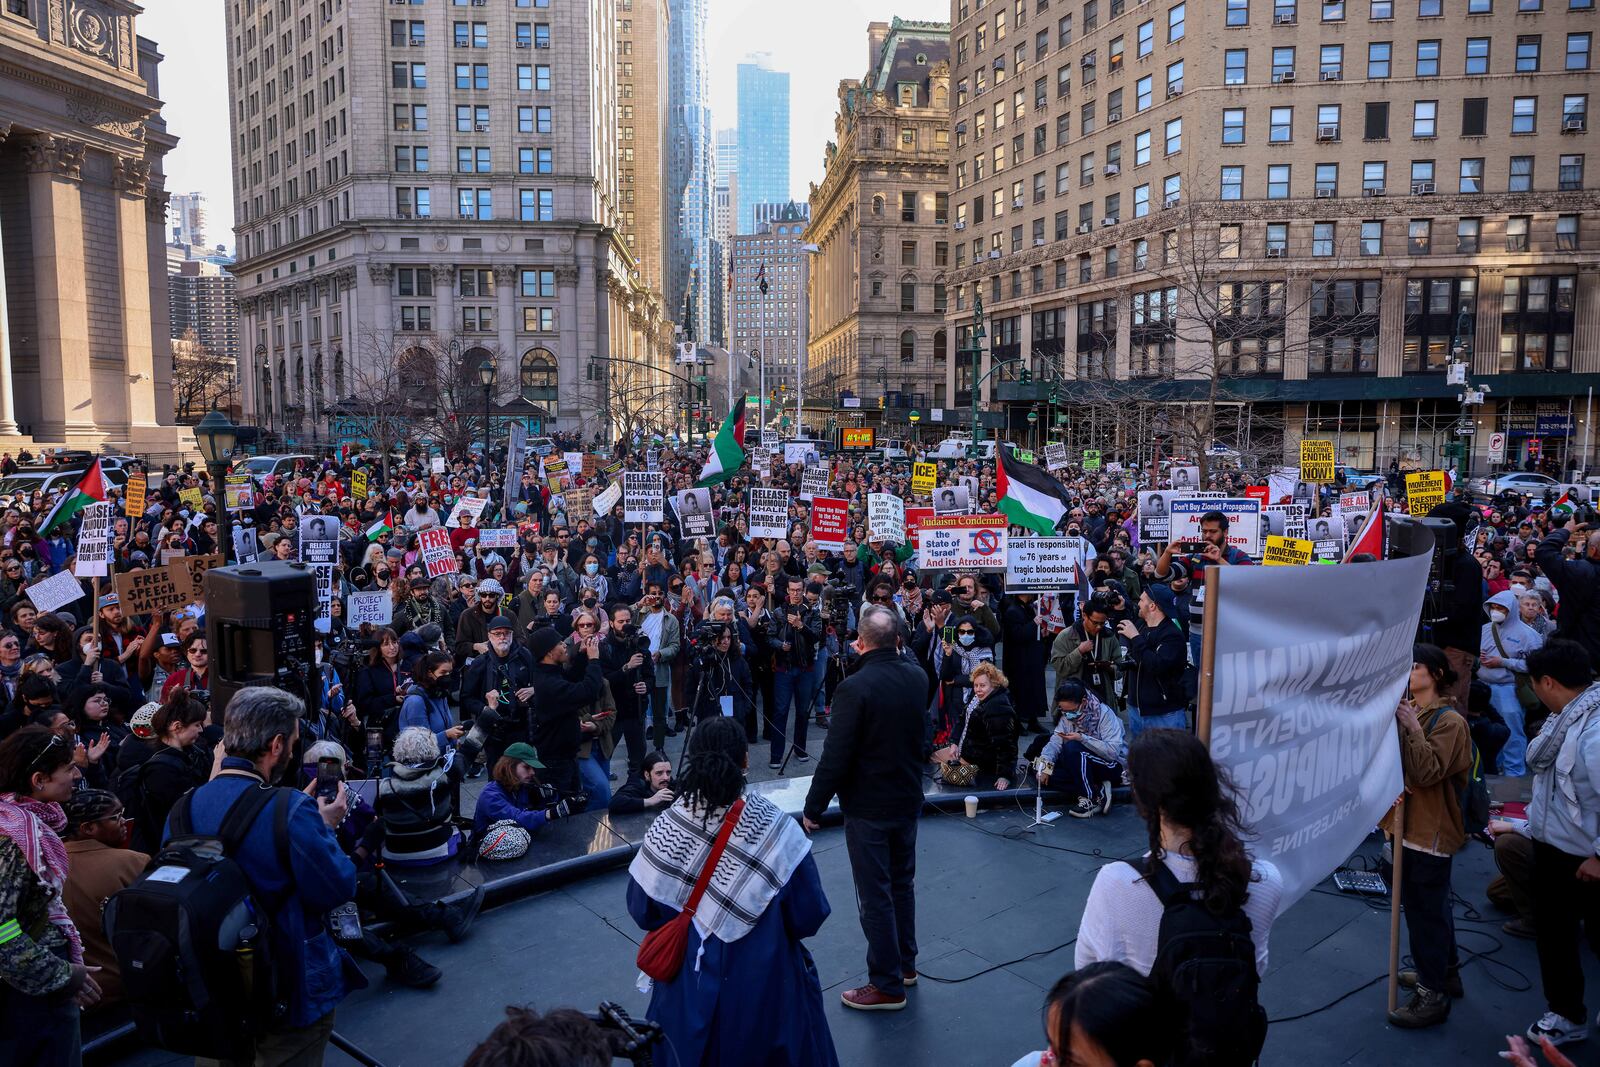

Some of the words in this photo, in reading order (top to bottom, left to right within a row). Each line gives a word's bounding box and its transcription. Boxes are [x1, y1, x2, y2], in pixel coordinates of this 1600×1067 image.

[1318, 453, 1332, 461] THE
[915, 464, 935, 477] ICE:
[626, 474, 662, 482] RELEASE
[1408, 480, 1442, 489] MOVEMENT
[752, 490, 787, 500] RELEASE
[752, 499, 787, 507] MAHMOUD
[1341, 498, 1354, 507] FREE
[1356, 496, 1368, 505] ALL
[1222, 503, 1256, 512] Propaganda
[1411, 504, 1419, 513] IS
[922, 516, 956, 526] Judaism
[958, 515, 1004, 525] Condemns
[1287, 528, 1304, 538] OFF
[97, 542, 106, 553] OFF
[951, 539, 960, 547] of
[1028, 540, 1034, 548] is
[1037, 540, 1079, 550] responsible
[1283, 540, 1297, 549] THE
[426, 552, 442, 561] END
[1267, 546, 1309, 560] MOVEMENT
[926, 559, 944, 567] And
[945, 558, 956, 566] its
[959, 556, 1002, 566] Atrocities
[1039, 554, 1059, 562] years
[1266, 555, 1292, 564] CONTINUES
[1014, 566, 1033, 575] tragic
[133, 572, 169, 587] FREE
[128, 583, 175, 601] SPEECH
[134, 593, 186, 612] MATTERS
[354, 596, 383, 605] PROTECT
[359, 604, 379, 613] FREE
[352, 613, 384, 623] SPEECH
